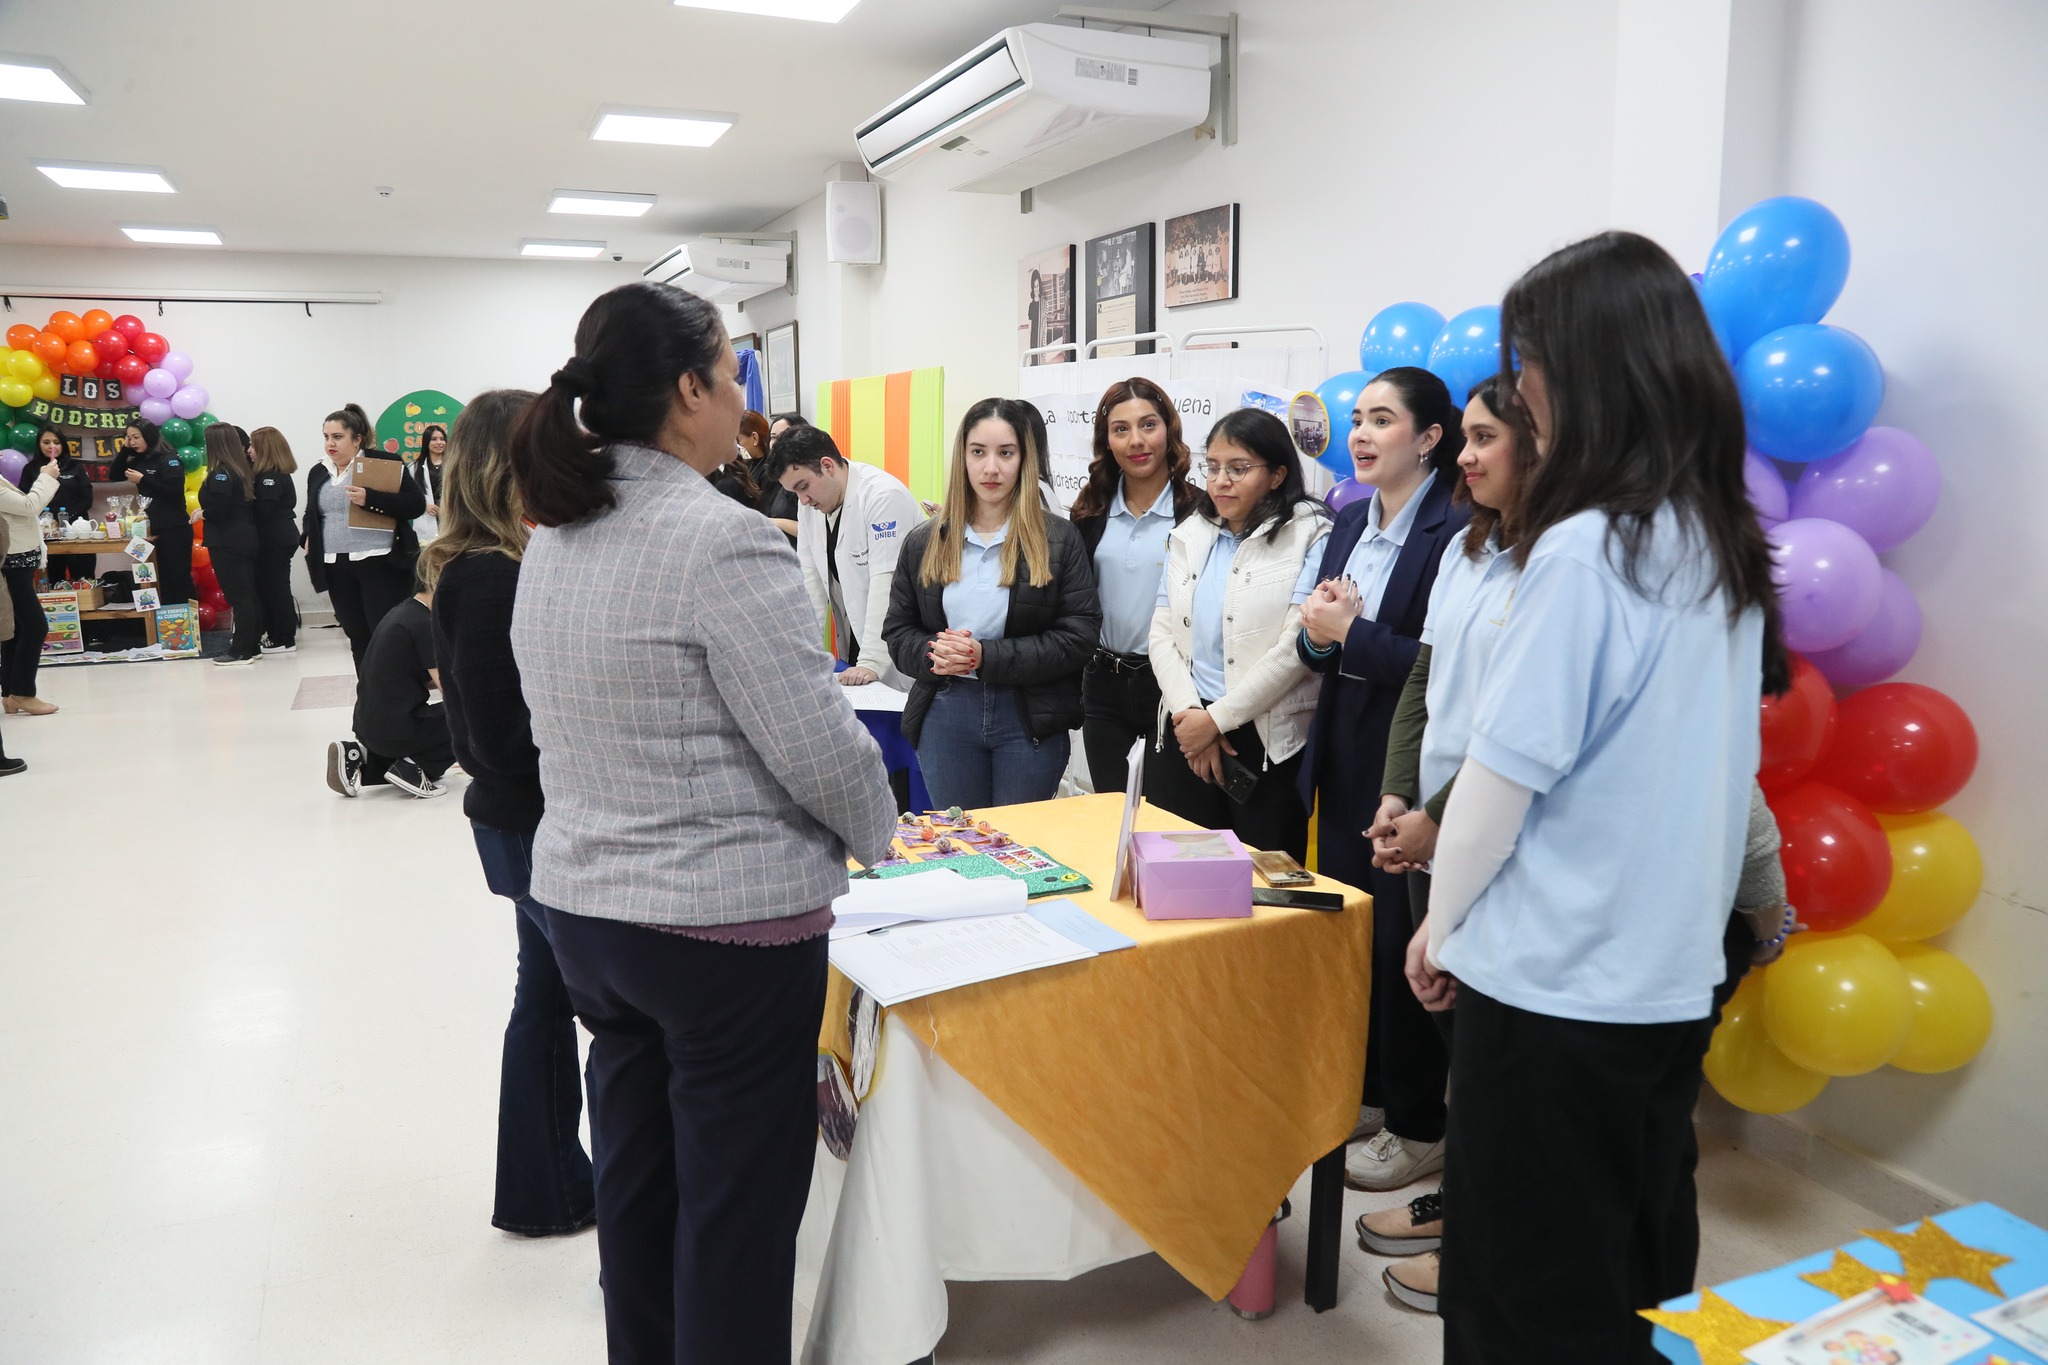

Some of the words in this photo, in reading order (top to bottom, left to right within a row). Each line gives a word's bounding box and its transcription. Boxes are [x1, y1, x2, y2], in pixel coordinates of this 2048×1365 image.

[62, 378, 120, 399] LOS
[1173, 398, 1211, 415] uena
[874, 531, 897, 541] UNIBE
